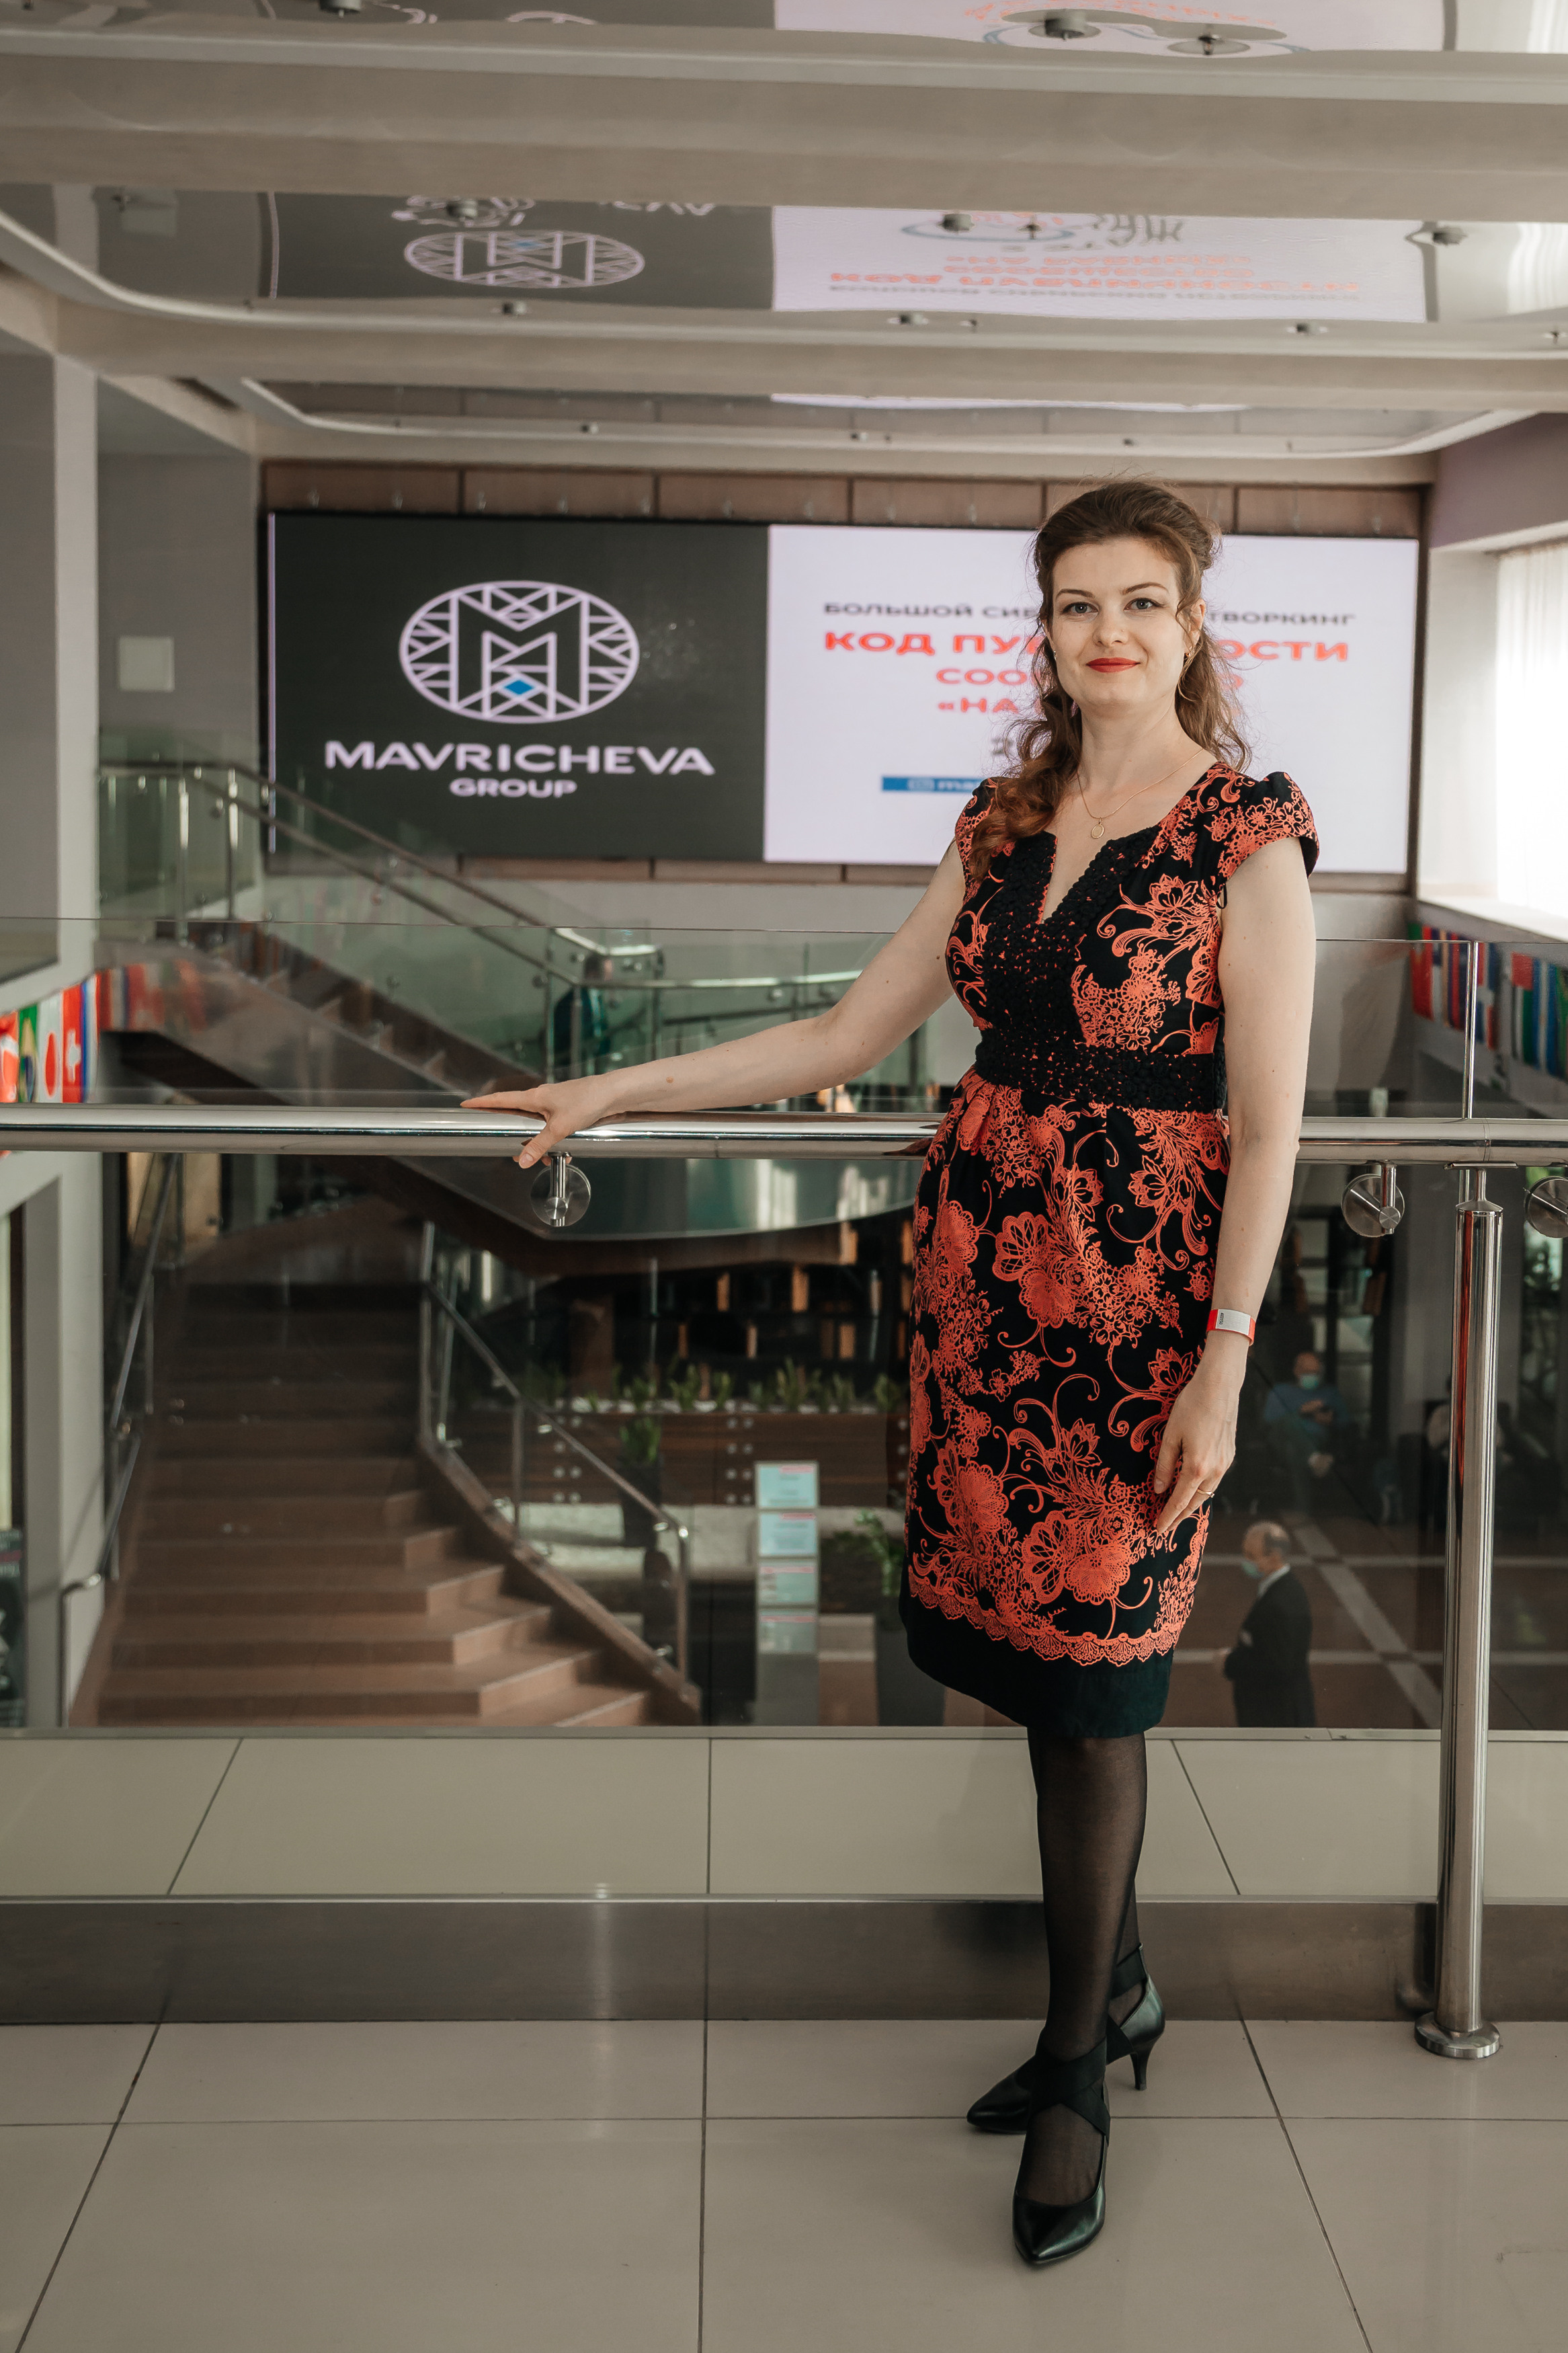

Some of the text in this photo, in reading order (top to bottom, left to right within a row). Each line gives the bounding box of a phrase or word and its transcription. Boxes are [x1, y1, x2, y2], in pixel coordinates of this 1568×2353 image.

[824, 602, 973, 617] БОЛЬШОЙ
[1208, 612, 1354, 626] ТВОРКИНГ
[825, 631, 936, 656] КОД
[325, 740, 715, 776] MAVRICHEVA
[449, 778, 577, 799] GROUP
